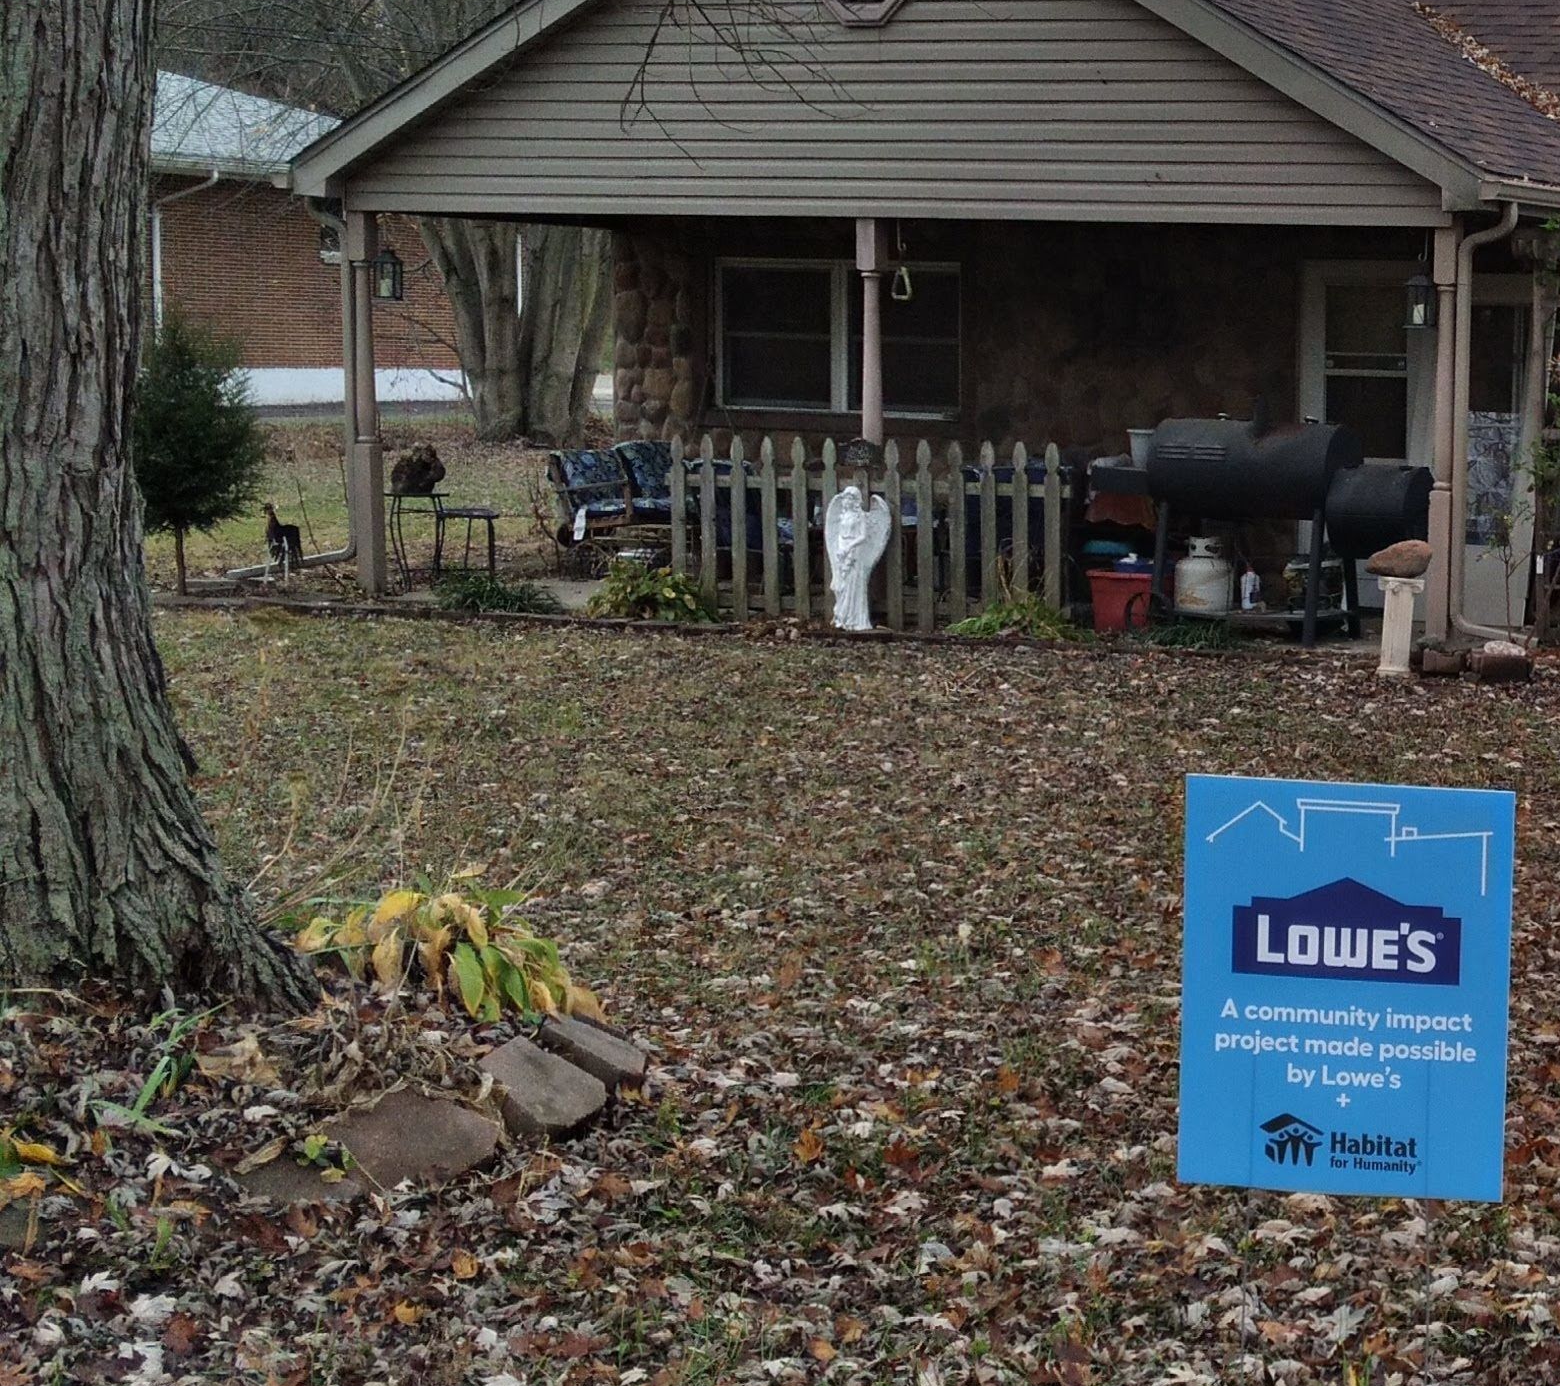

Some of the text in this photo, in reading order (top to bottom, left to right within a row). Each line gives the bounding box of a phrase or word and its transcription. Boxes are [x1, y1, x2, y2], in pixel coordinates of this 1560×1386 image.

[1256, 914, 1437, 973] LOWE'S
[1220, 998, 1472, 1033] A community impact
[1215, 1030, 1477, 1063] project made possible
[1287, 1063, 1402, 1089] by Lowe's
[1330, 1131, 1418, 1159] Habitat
[1330, 1155, 1417, 1176] for Humanity
